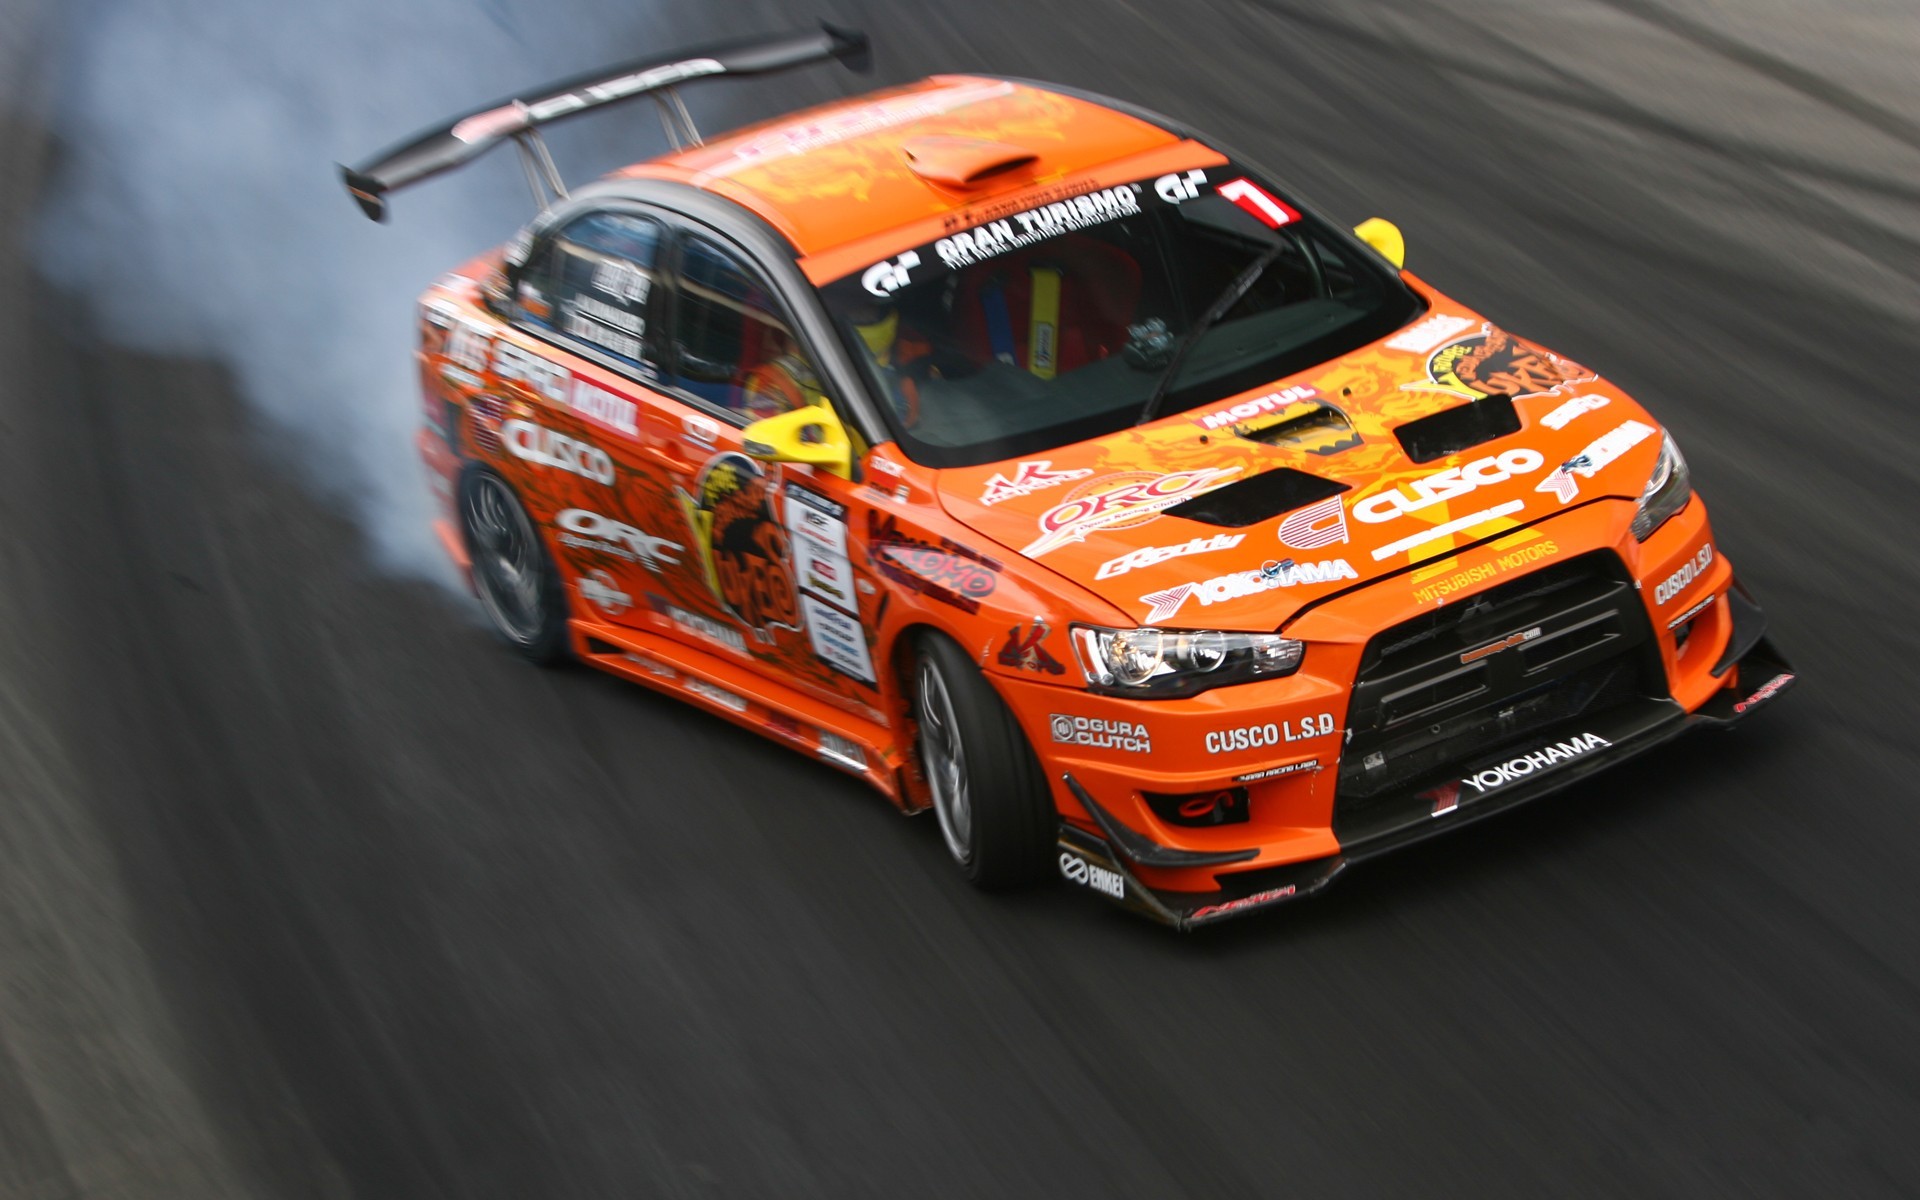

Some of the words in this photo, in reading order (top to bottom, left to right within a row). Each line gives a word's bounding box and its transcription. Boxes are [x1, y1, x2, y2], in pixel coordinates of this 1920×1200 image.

[935, 222, 1014, 260] GRAN
[1014, 185, 1138, 234] TURISMO
[1217, 178, 1290, 226] 1
[1201, 384, 1317, 430] MOTUL
[502, 418, 616, 487] CUSCO
[1040, 467, 1222, 534] ORC
[1353, 448, 1544, 523] CUSCO
[1411, 561, 1497, 604] MITSUBISHI
[1497, 540, 1559, 572] MOTORS
[1654, 562, 1693, 606] CUSCO
[1074, 716, 1150, 738] OGURA
[1076, 731, 1151, 754] CLUTCH
[1205, 722, 1279, 754] CUSCO
[1283, 713, 1335, 742] L.S.D
[1462, 732, 1613, 792] YOKOHAMA
[1089, 863, 1125, 899] ENKEI
